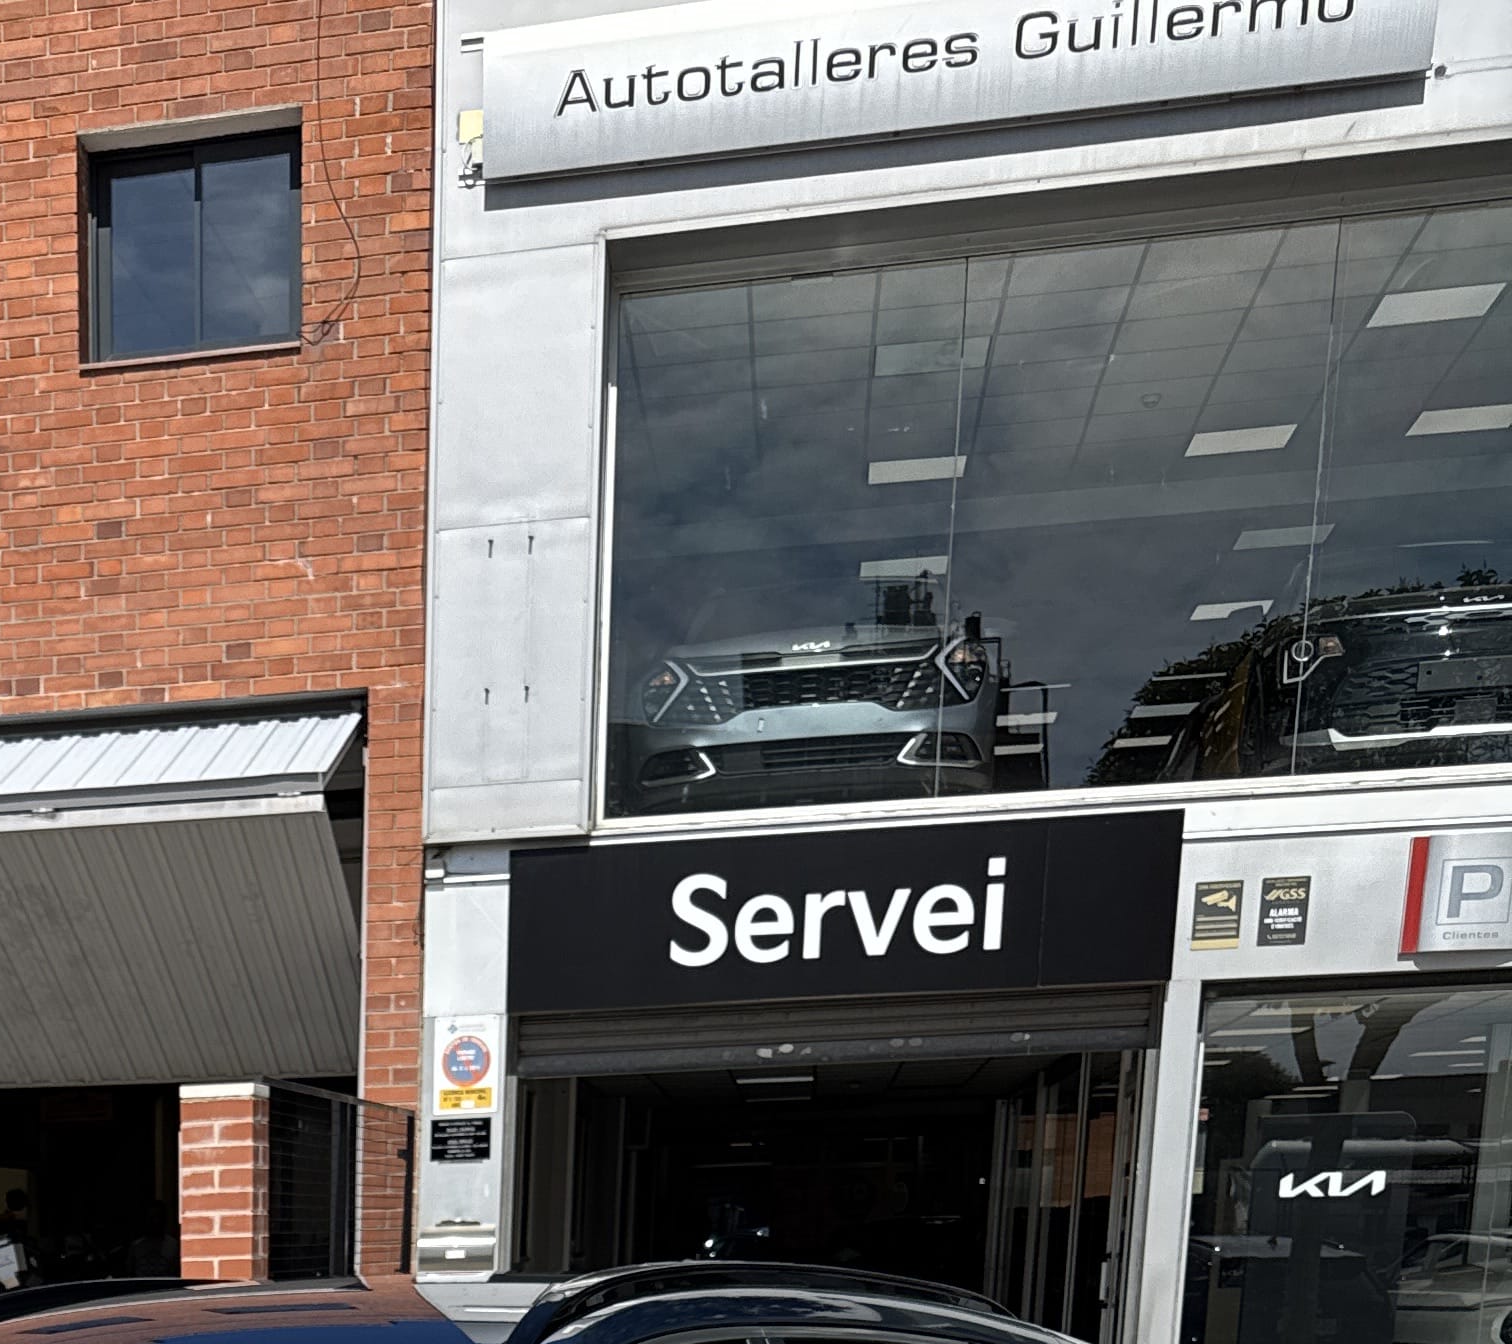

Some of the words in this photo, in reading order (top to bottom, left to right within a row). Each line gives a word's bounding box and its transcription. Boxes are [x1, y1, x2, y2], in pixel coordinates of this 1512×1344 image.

[553, 32, 980, 118] Autotalleres
[669, 856, 1006, 967] Servei
[1446, 864, 1504, 918] P
[1442, 931, 1499, 941] Clientes
[1279, 1170, 1386, 1198] KIA
